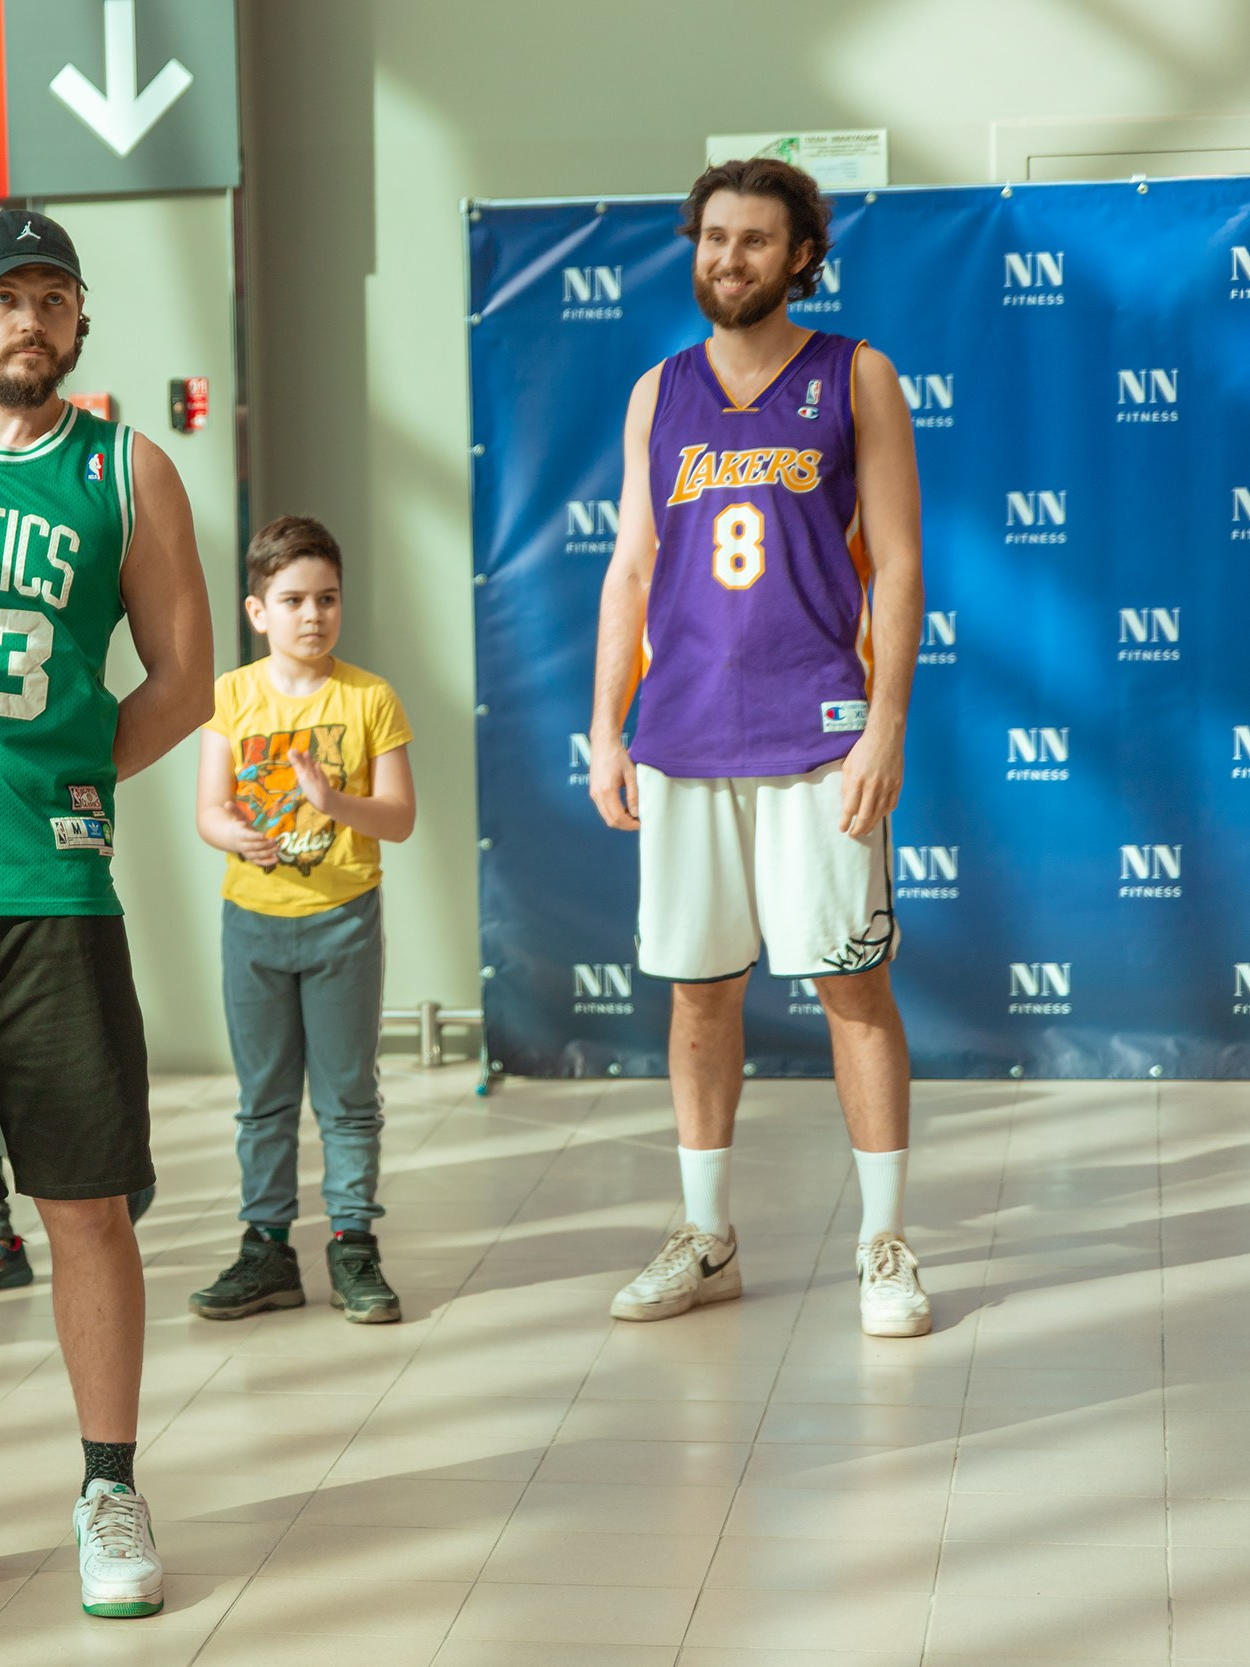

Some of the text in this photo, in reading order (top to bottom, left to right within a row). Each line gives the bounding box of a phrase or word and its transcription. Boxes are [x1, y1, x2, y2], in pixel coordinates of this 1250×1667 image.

[815, 257, 842, 294] N
[1003, 251, 1065, 287] NN
[1230, 246, 1250, 280] N
[562, 266, 623, 302] NN
[1003, 293, 1065, 306] FITNESS
[562, 307, 623, 320] FITNESS
[787, 300, 842, 313] ITNESS
[1116, 368, 1179, 404] NN
[911, 415, 954, 428] NESS
[1116, 411, 1179, 423] FITNESS
[666, 442, 823, 507] LAKERS
[1005, 490, 1067, 525] NN
[1231, 487, 1250, 521] N
[565, 541, 614, 553] FITNE
[712, 502, 766, 590] 8
[1005, 532, 1067, 544] FITNESS
[919, 610, 958, 645] N
[1118, 607, 1181, 643] NN
[917, 652, 958, 664] NESS
[1117, 649, 1181, 661] FITNESS
[1007, 727, 1070, 763] NN
[1232, 725, 1250, 760] N
[1006, 769, 1070, 781] FITNESS
[897, 846, 959, 881] NN
[1119, 844, 1182, 880] NN
[896, 887, 959, 899] FITNESS
[1118, 886, 1182, 898] FITNESS
[574, 963, 632, 998] NN
[1009, 962, 1072, 997] NN
[1234, 962, 1250, 997] N
[574, 1003, 634, 1015] FITNESS
[789, 1002, 824, 1015] FITN
[1009, 1003, 1072, 1015] FITNESS
